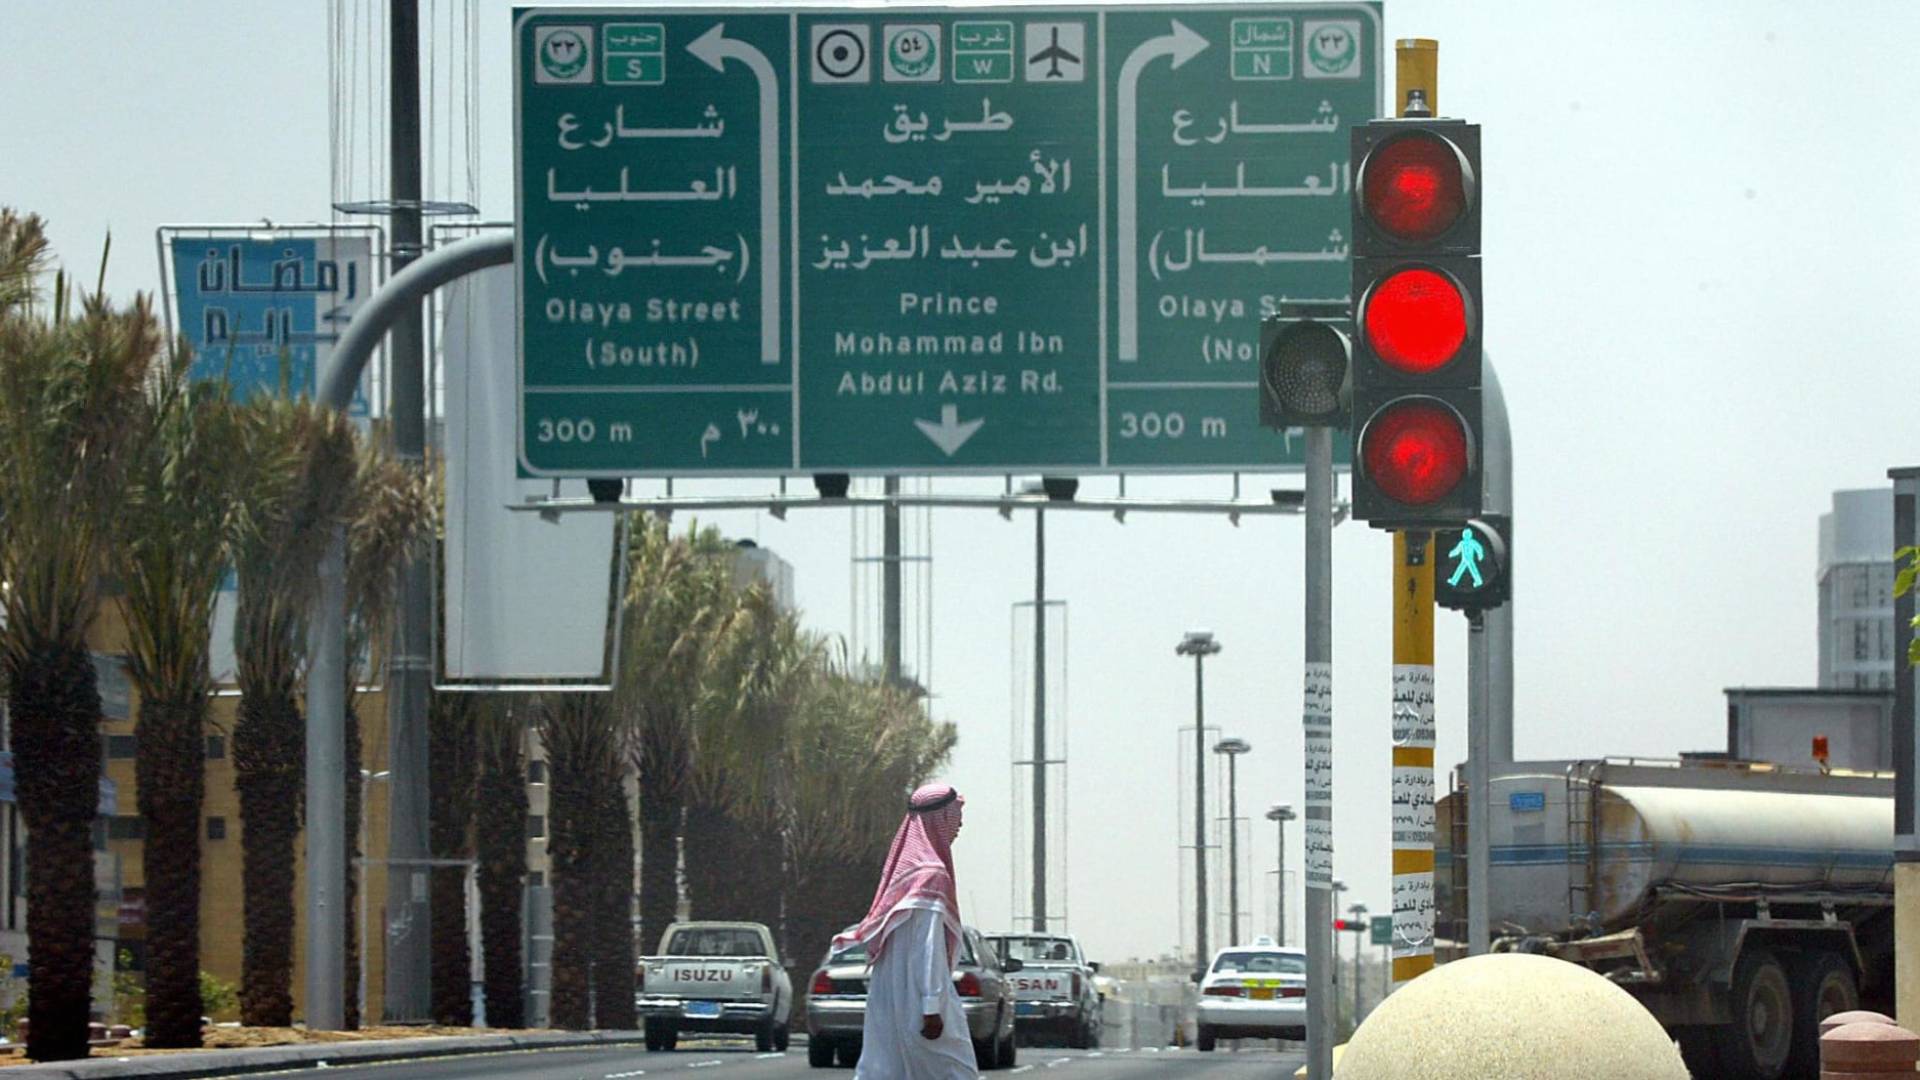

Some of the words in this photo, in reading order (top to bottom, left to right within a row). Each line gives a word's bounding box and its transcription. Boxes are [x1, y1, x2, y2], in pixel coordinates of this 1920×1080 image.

[960, 30, 1006, 47] غرب
[1238, 24, 1286, 46] شمال
[626, 59, 642, 79] S
[973, 59, 993, 75] W
[1253, 53, 1271, 74] N
[557, 104, 725, 150] شارع
[883, 97, 1014, 143] طريق
[1172, 100, 1339, 146] شارع
[547, 165, 737, 211] العليا
[826, 171, 943, 199] محمد
[965, 149, 1072, 204] الأمير
[1161, 161, 1350, 206] العليا
[535, 234, 750, 284] (جنوب)
[812, 225, 930, 270] العزيز
[940, 235, 1018, 268] عبد
[1029, 223, 1087, 268] ابن
[1148, 228, 1350, 280] شمال)
[199, 245, 356, 300] رمضان
[545, 297, 632, 327] Olaya
[646, 298, 741, 321] Street
[900, 292, 998, 315] Prince
[1159, 294, 1244, 323] Olaya
[585, 337, 699, 369] (South)
[835, 332, 1003, 355] Mohammad
[1018, 331, 1064, 353] Ibn
[837, 371, 924, 394] Abdul
[938, 370, 1007, 393] Aziz
[1021, 369, 1063, 393] Rd.
[537, 418, 596, 443] 300
[610, 422, 632, 442] m
[1119, 412, 1185, 438] 300
[1201, 417, 1227, 437] m
[701, 423, 721, 458] م
[674, 969, 733, 982] ISUZU
[1010, 978, 1059, 991] SAN
